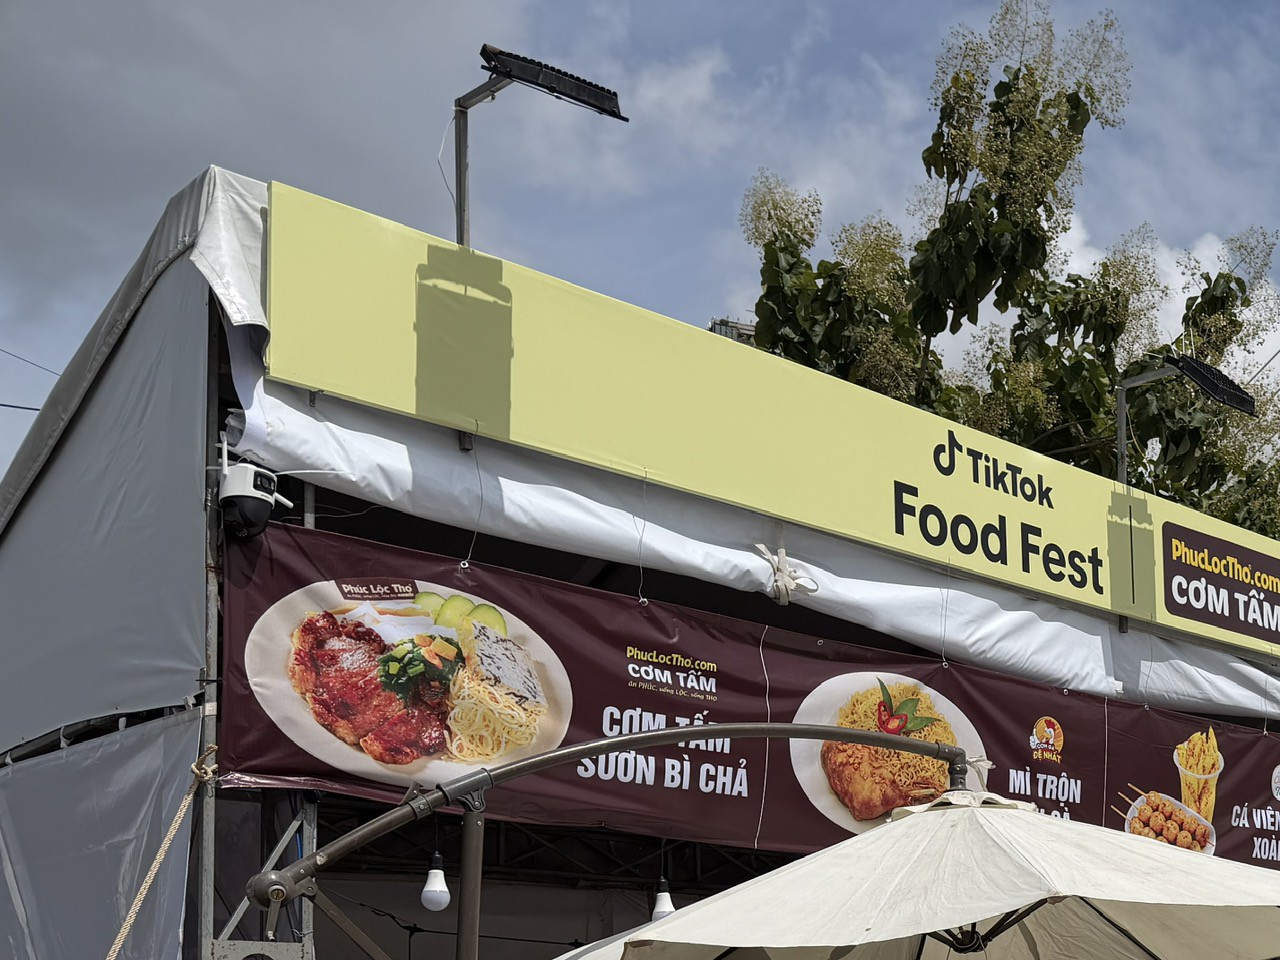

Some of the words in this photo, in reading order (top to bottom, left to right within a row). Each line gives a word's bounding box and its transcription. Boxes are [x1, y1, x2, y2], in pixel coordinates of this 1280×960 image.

[967, 449, 1054, 509] TikTok
[894, 480, 1008, 566] Food
[1020, 521, 1104, 595] Fest
[1171, 575, 1229, 617] CƠM
[627, 663, 673, 685] CƠM
[676, 669, 716, 693] TẤM
[664, 754, 691, 790] BÌ
[699, 758, 749, 798] CHẢ
[1009, 765, 1032, 796] MÌ
[1036, 771, 1081, 807] TRỘN
[1231, 801, 1250, 829] CÁ
